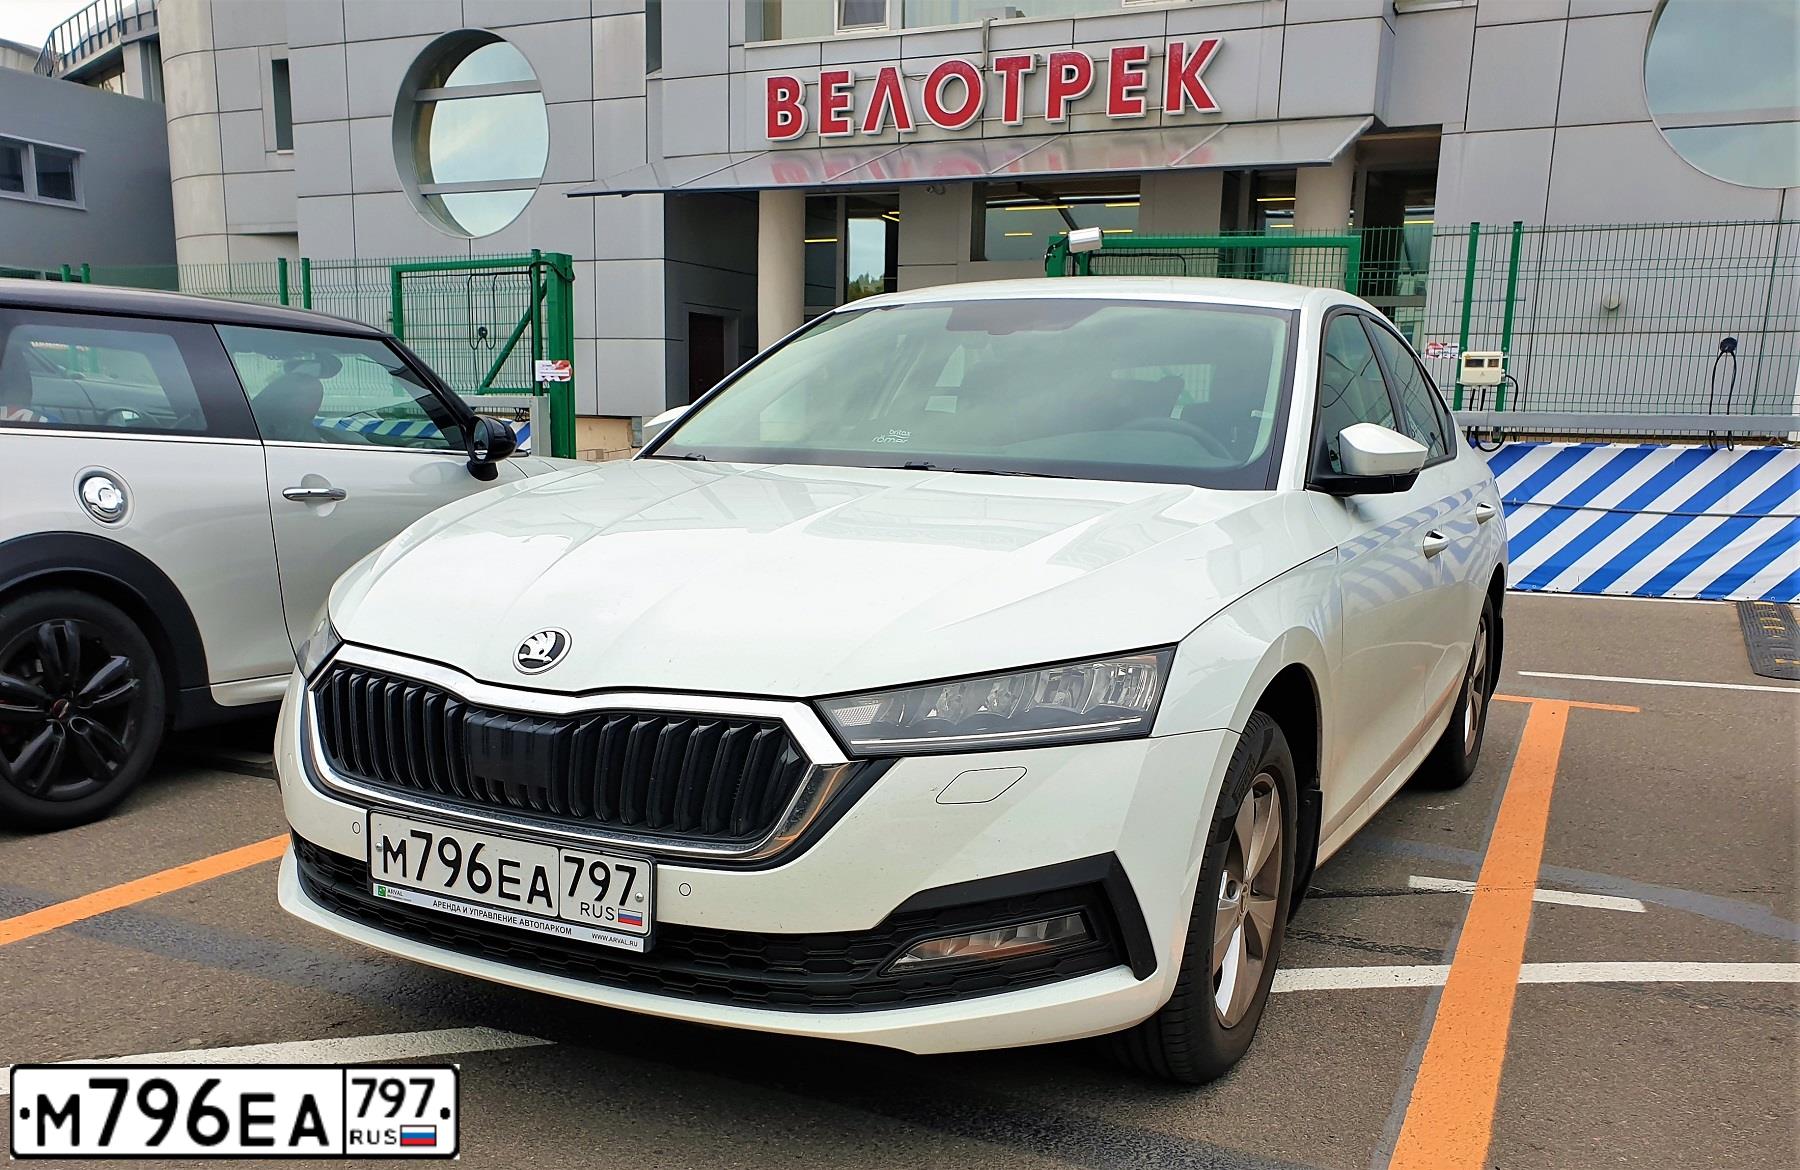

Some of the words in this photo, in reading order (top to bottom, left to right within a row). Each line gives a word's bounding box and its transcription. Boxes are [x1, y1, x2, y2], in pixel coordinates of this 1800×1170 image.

[765, 37, 1225, 141] ВЕЛОТРЕК
[382, 829, 553, 909] М796ЕА
[564, 855, 637, 907] 797
[433, 900, 461, 913] АРЕНДА
[462, 906, 468, 914] И
[469, 907, 518, 925] УПРАВЛЕНИЕ
[519, 918, 572, 935] АВТОПАРКОМ
[580, 901, 615, 921] RUS
